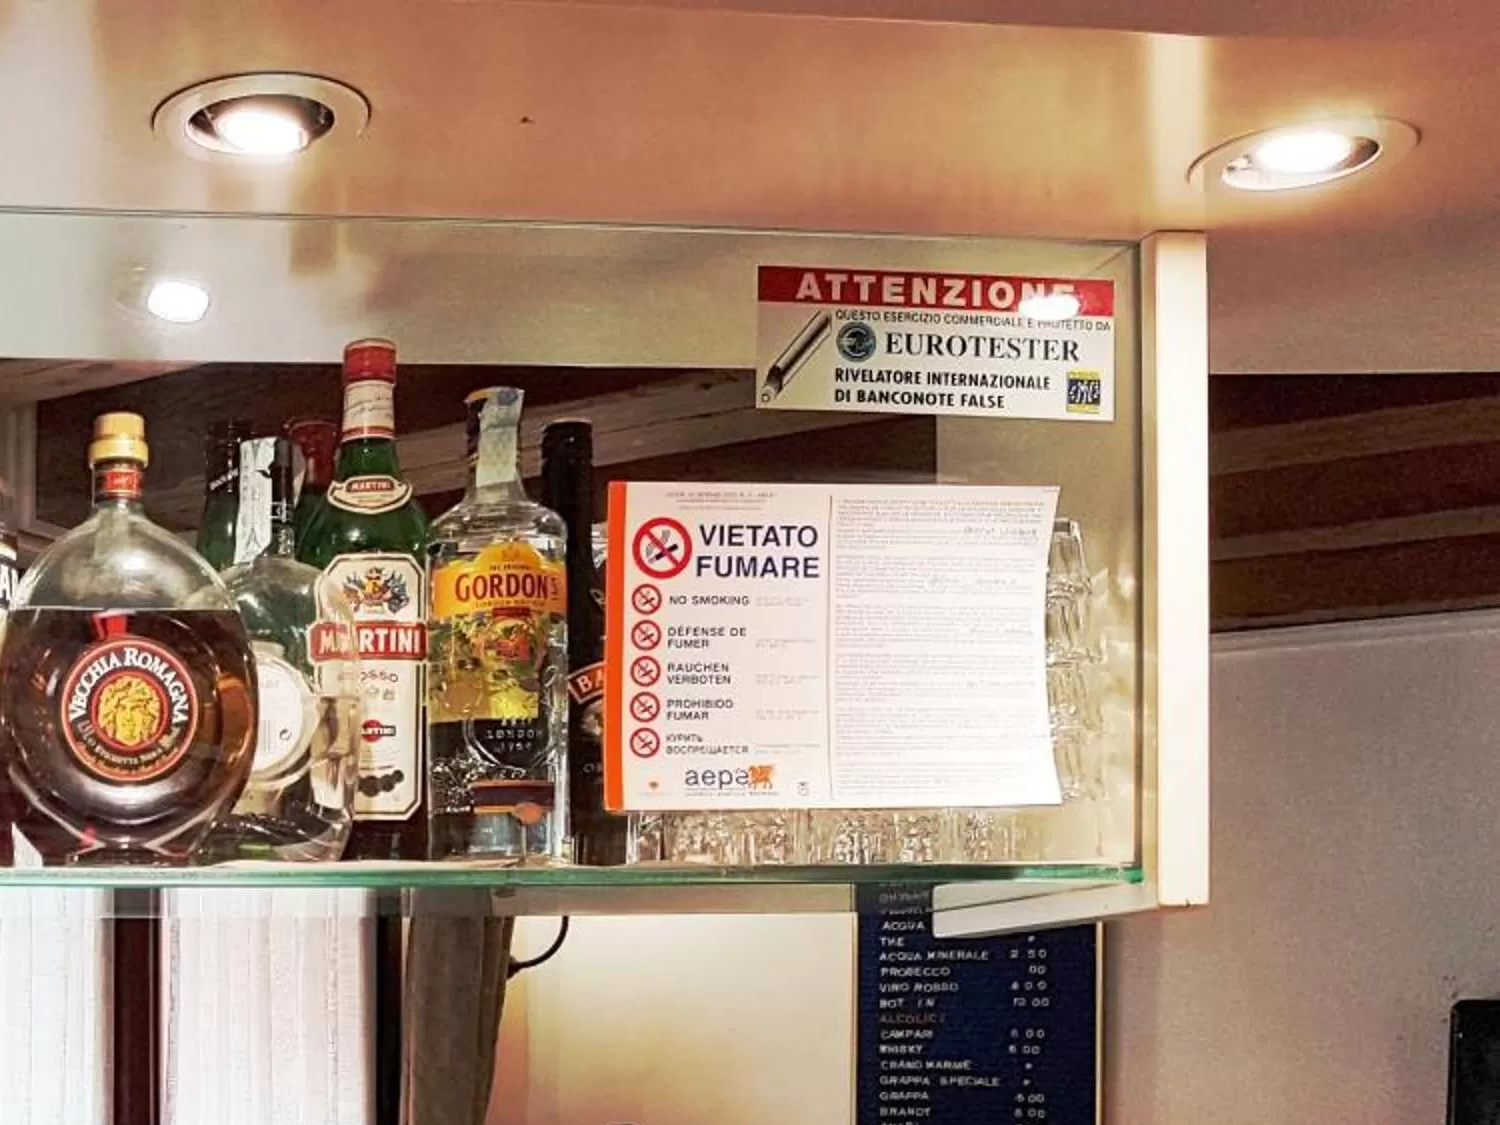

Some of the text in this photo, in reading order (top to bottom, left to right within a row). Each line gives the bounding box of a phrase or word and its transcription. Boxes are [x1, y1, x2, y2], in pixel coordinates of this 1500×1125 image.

[835, 309, 881, 322] QUESTO
[886, 332, 1080, 362] EUROTESTER
[835, 368, 1051, 390] RIVELATORE INTERNAZIONALE
[835, 388, 1006, 409] DI BANCONOTE FALSE
[700, 525, 819, 548] VIETATO
[696, 556, 820, 579] FUMARE
[669, 595, 687, 606] NO
[692, 595, 751, 606] SMOKING
[729, 627, 747, 637] DE
[667, 639, 709, 649] FUMER
[667, 662, 729, 673] RAUCHEN
[68, 647, 189, 724] VECCHIA ROMAGNA
[667, 674, 731, 685] VERBOTEN
[667, 711, 709, 721] FUMAR
